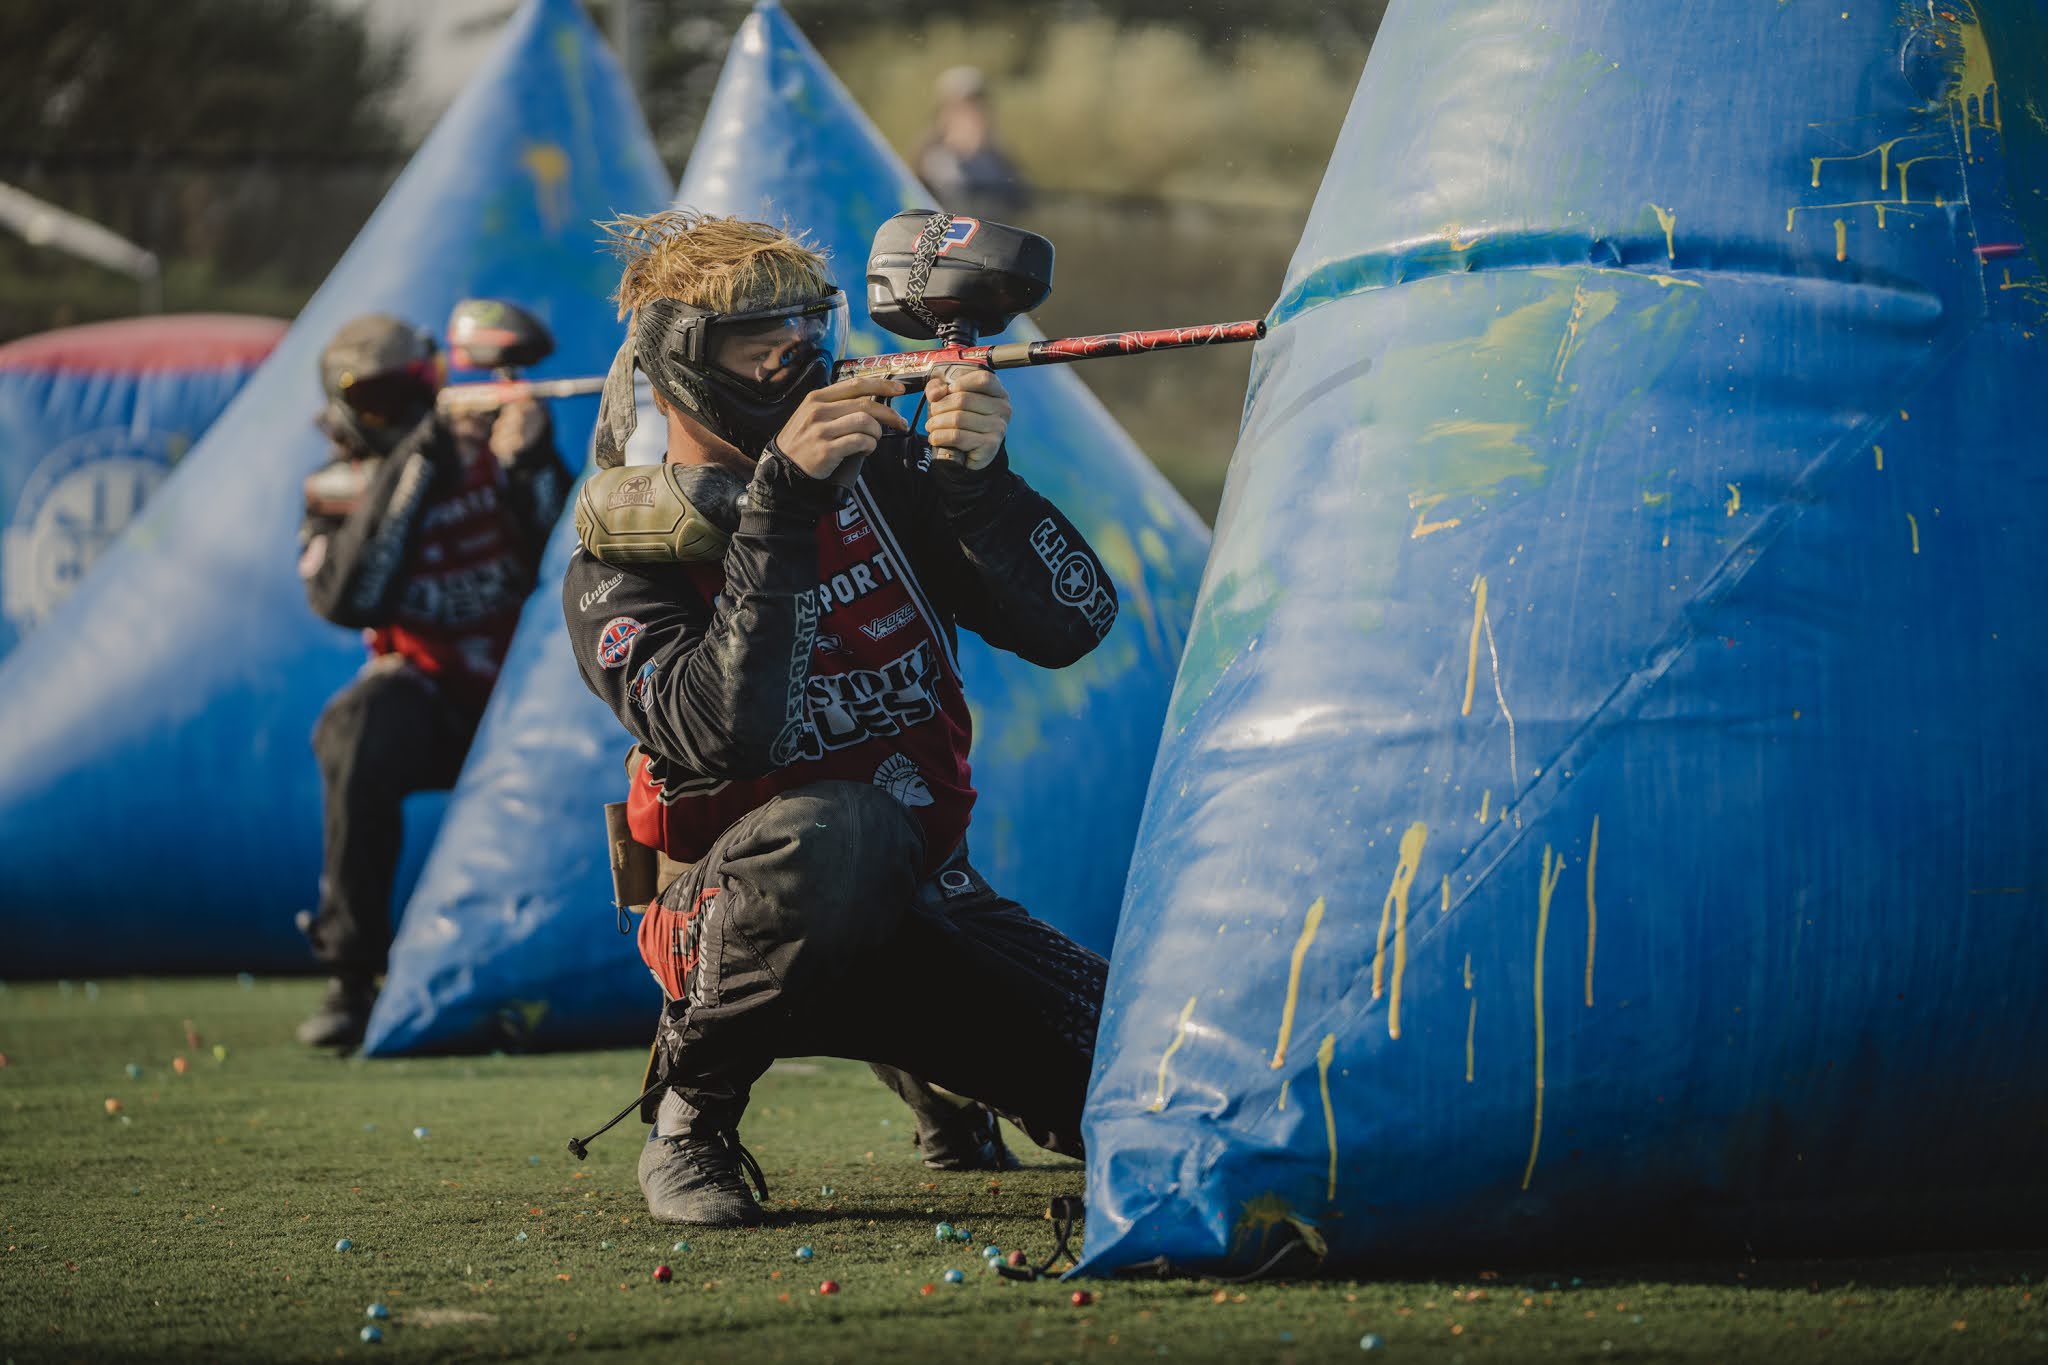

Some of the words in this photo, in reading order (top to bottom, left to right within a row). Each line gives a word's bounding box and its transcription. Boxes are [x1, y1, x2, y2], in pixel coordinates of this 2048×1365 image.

[579, 572, 625, 612] Anthrax
[818, 552, 894, 614] PORT
[859, 602, 914, 641] VFORC
